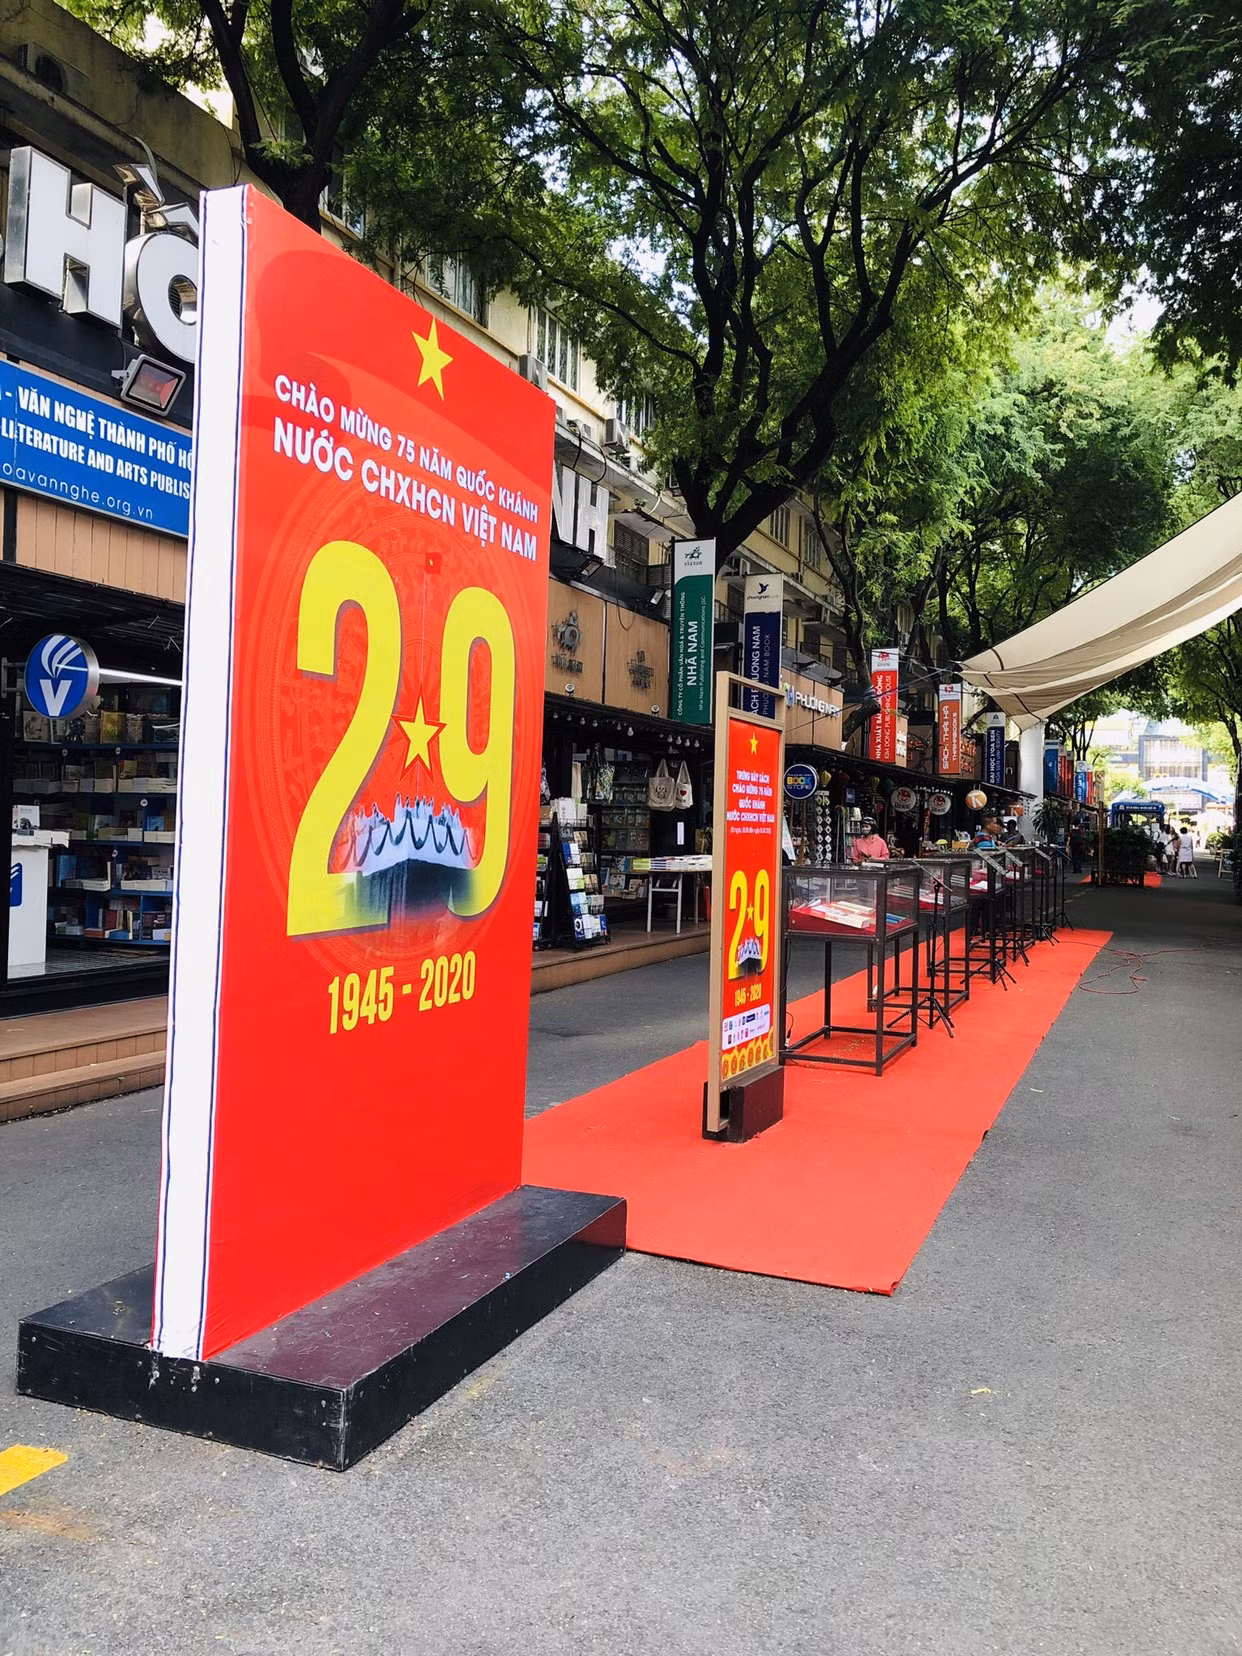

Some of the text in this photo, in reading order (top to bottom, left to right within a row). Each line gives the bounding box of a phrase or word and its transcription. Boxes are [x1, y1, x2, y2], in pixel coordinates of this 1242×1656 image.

[18, 386, 50, 419] VĂN
[54, 401, 95, 440] NGHỆ
[98, 417, 146, 453] THÀNH
[148, 437, 177, 464] PHỐ
[275, 375, 538, 523] CHÀO MỪNG 75 NĂM QUỐC KHÁNH
[87, 449, 114, 473] AND
[116, 459, 148, 485] ARTS
[150, 470, 190, 500] PUBLIS
[274, 416, 537, 560] NƯỚC CHXHCN VIỆT NAM
[685, 621, 698, 686] NHÃ NAM
[751, 651, 760, 692] PƯƠNG
[752, 626, 760, 649] NAM
[762, 681, 770, 715] PHUOG
[286, 539, 517, 937] 2 9
[874, 744, 882, 759] NHÀ
[728, 869, 769, 980] 2 9
[327, 950, 476, 1035] 1945 - 2020
